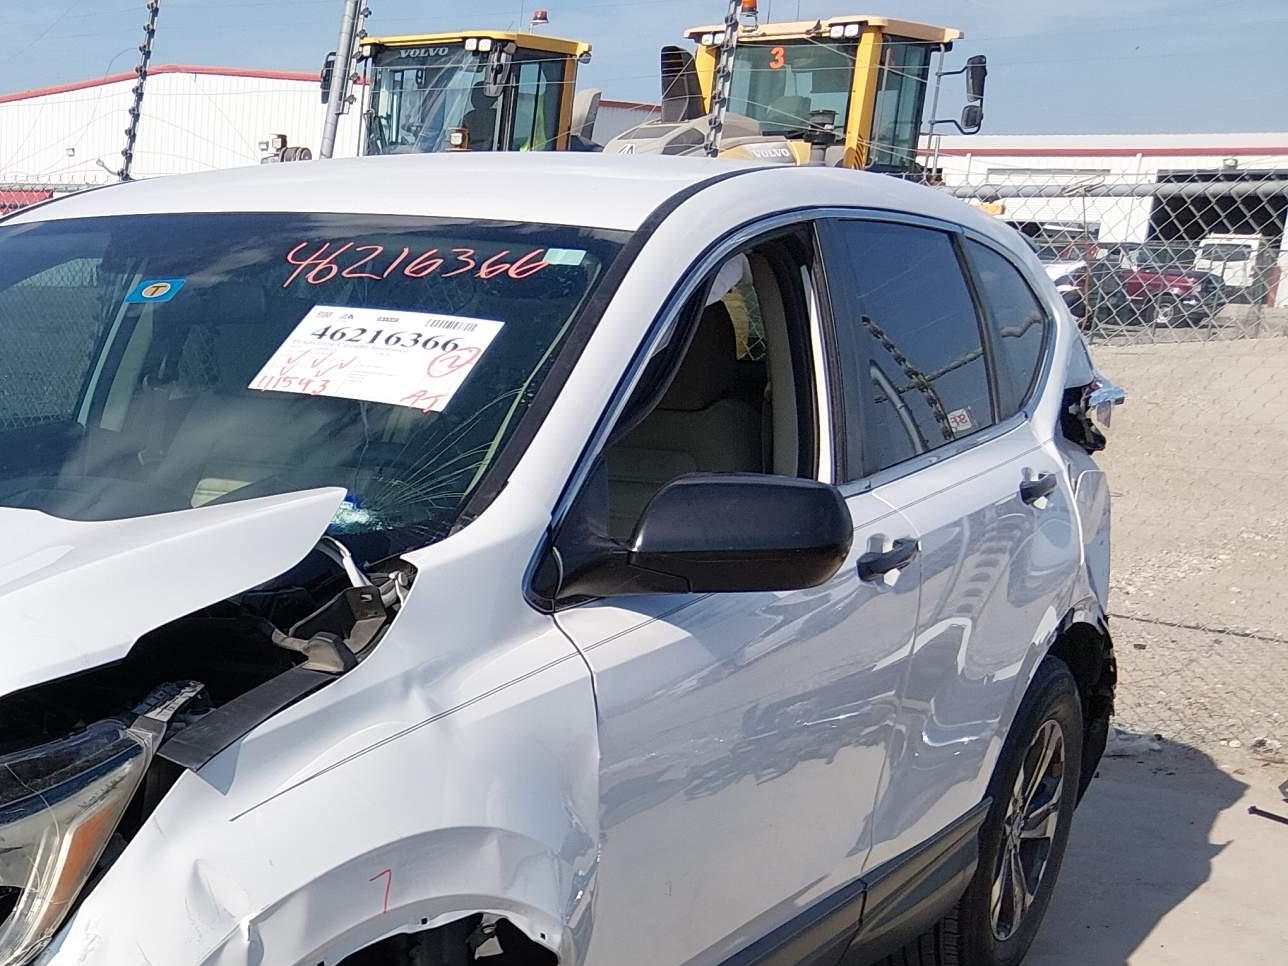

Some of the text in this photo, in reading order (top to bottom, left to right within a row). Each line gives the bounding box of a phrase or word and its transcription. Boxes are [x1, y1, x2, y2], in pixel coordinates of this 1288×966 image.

[399, 46, 449, 59] VOLVO
[769, 46, 785, 69] 3
[751, 147, 791, 159] VOLVO
[282, 241, 550, 288] 46216366
[311, 325, 465, 353] 46216366
